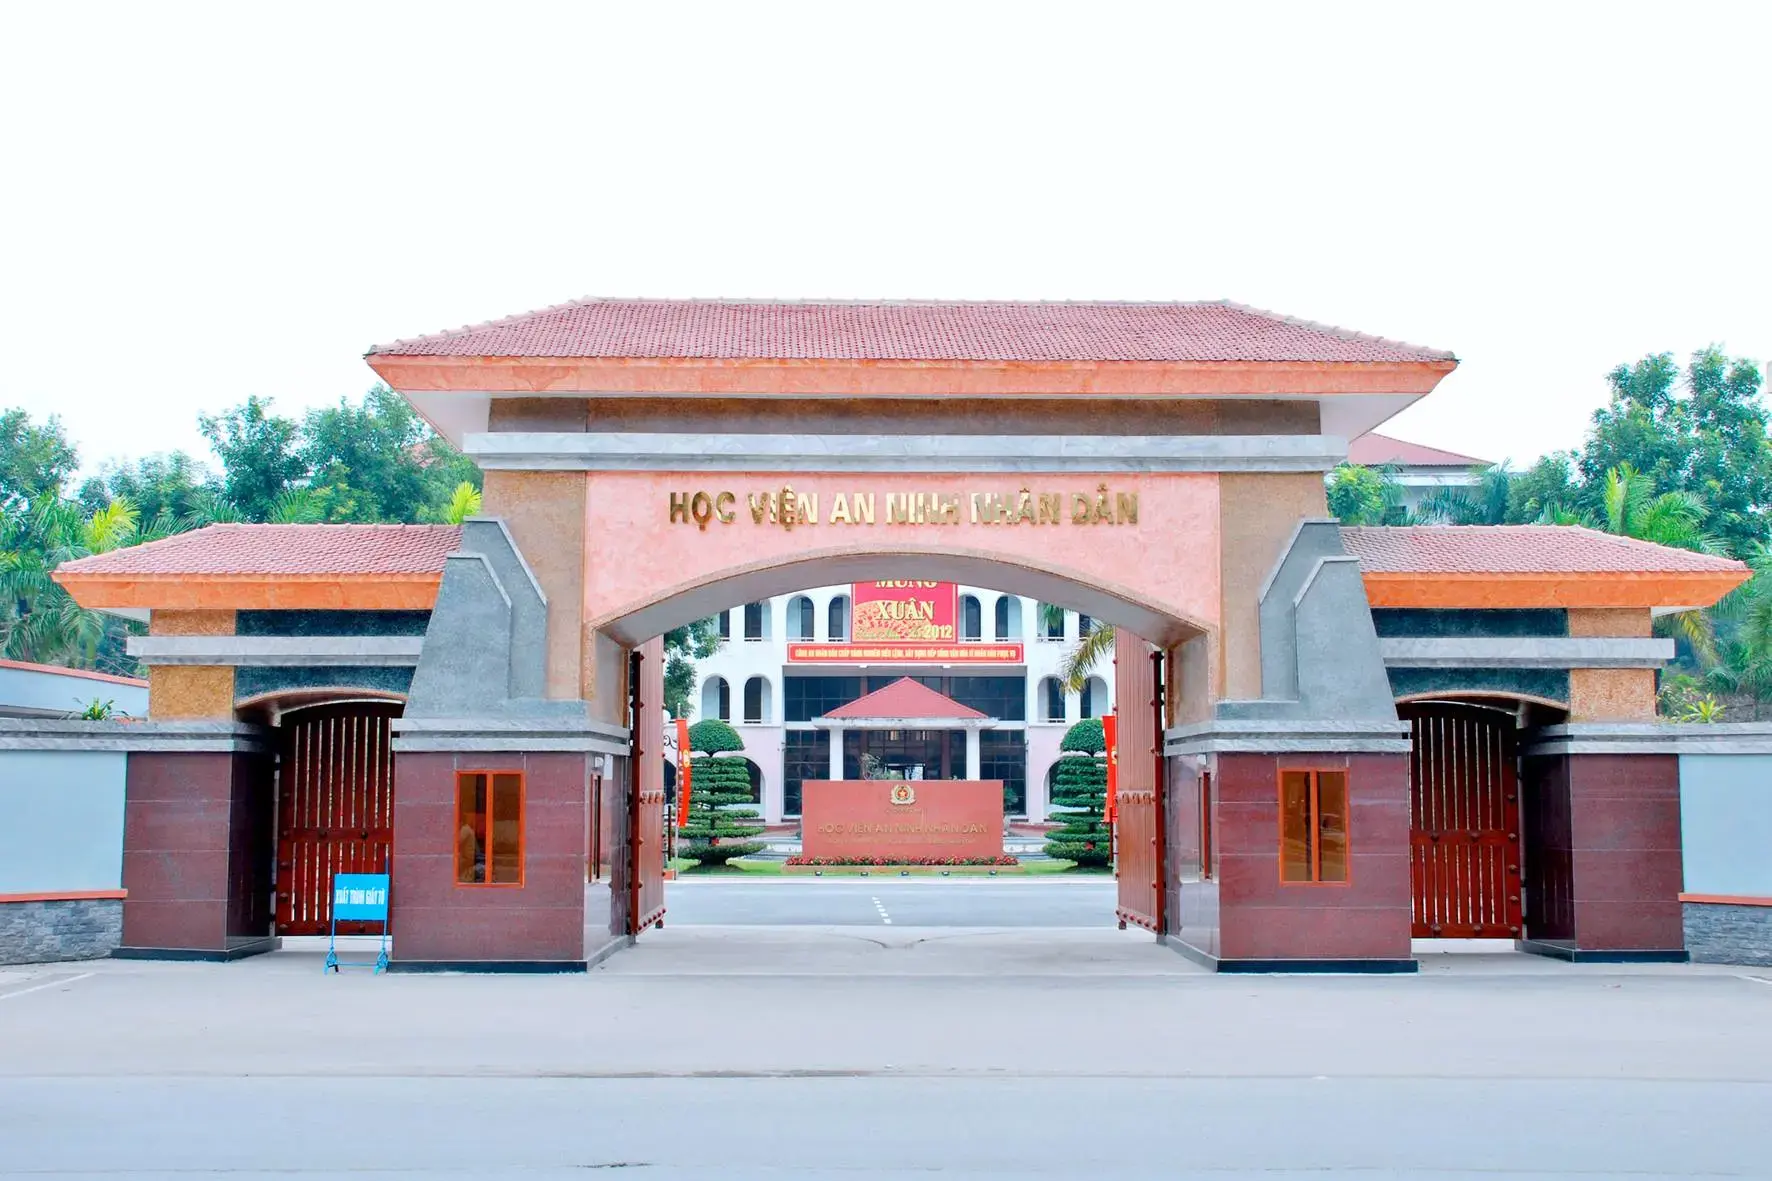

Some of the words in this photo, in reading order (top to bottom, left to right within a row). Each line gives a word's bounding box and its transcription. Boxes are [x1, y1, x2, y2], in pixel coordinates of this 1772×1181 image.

[669, 491, 736, 531] HỌC
[747, 484, 819, 531] VIỆN
[829, 492, 876, 525] AN
[885, 492, 960, 525] NINH
[969, 487, 1061, 525] NHÂN
[1071, 484, 1138, 525] DÂN
[875, 597, 935, 621] XUÂN
[923, 624, 953, 640] 2012
